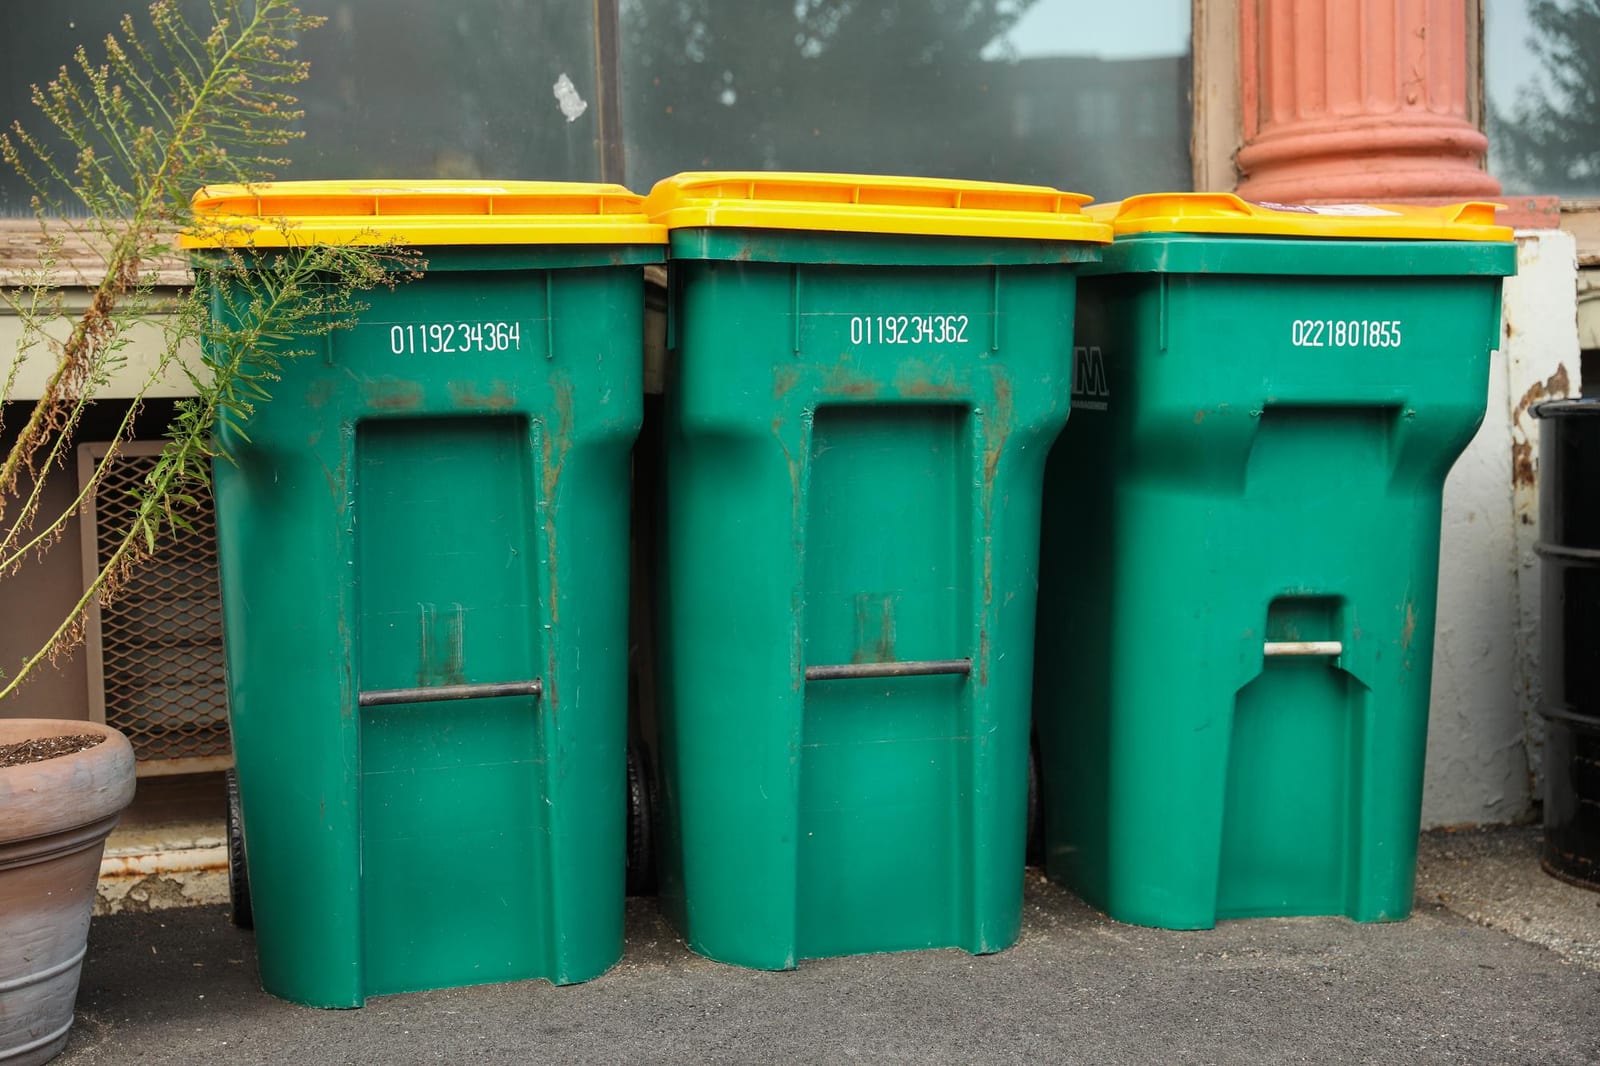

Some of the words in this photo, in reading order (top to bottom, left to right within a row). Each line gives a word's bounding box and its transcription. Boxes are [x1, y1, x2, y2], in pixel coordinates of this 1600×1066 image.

[390, 322, 520, 354] 0119234364
[851, 315, 968, 344] 0119234362
[1292, 320, 1401, 347] 0221801855
